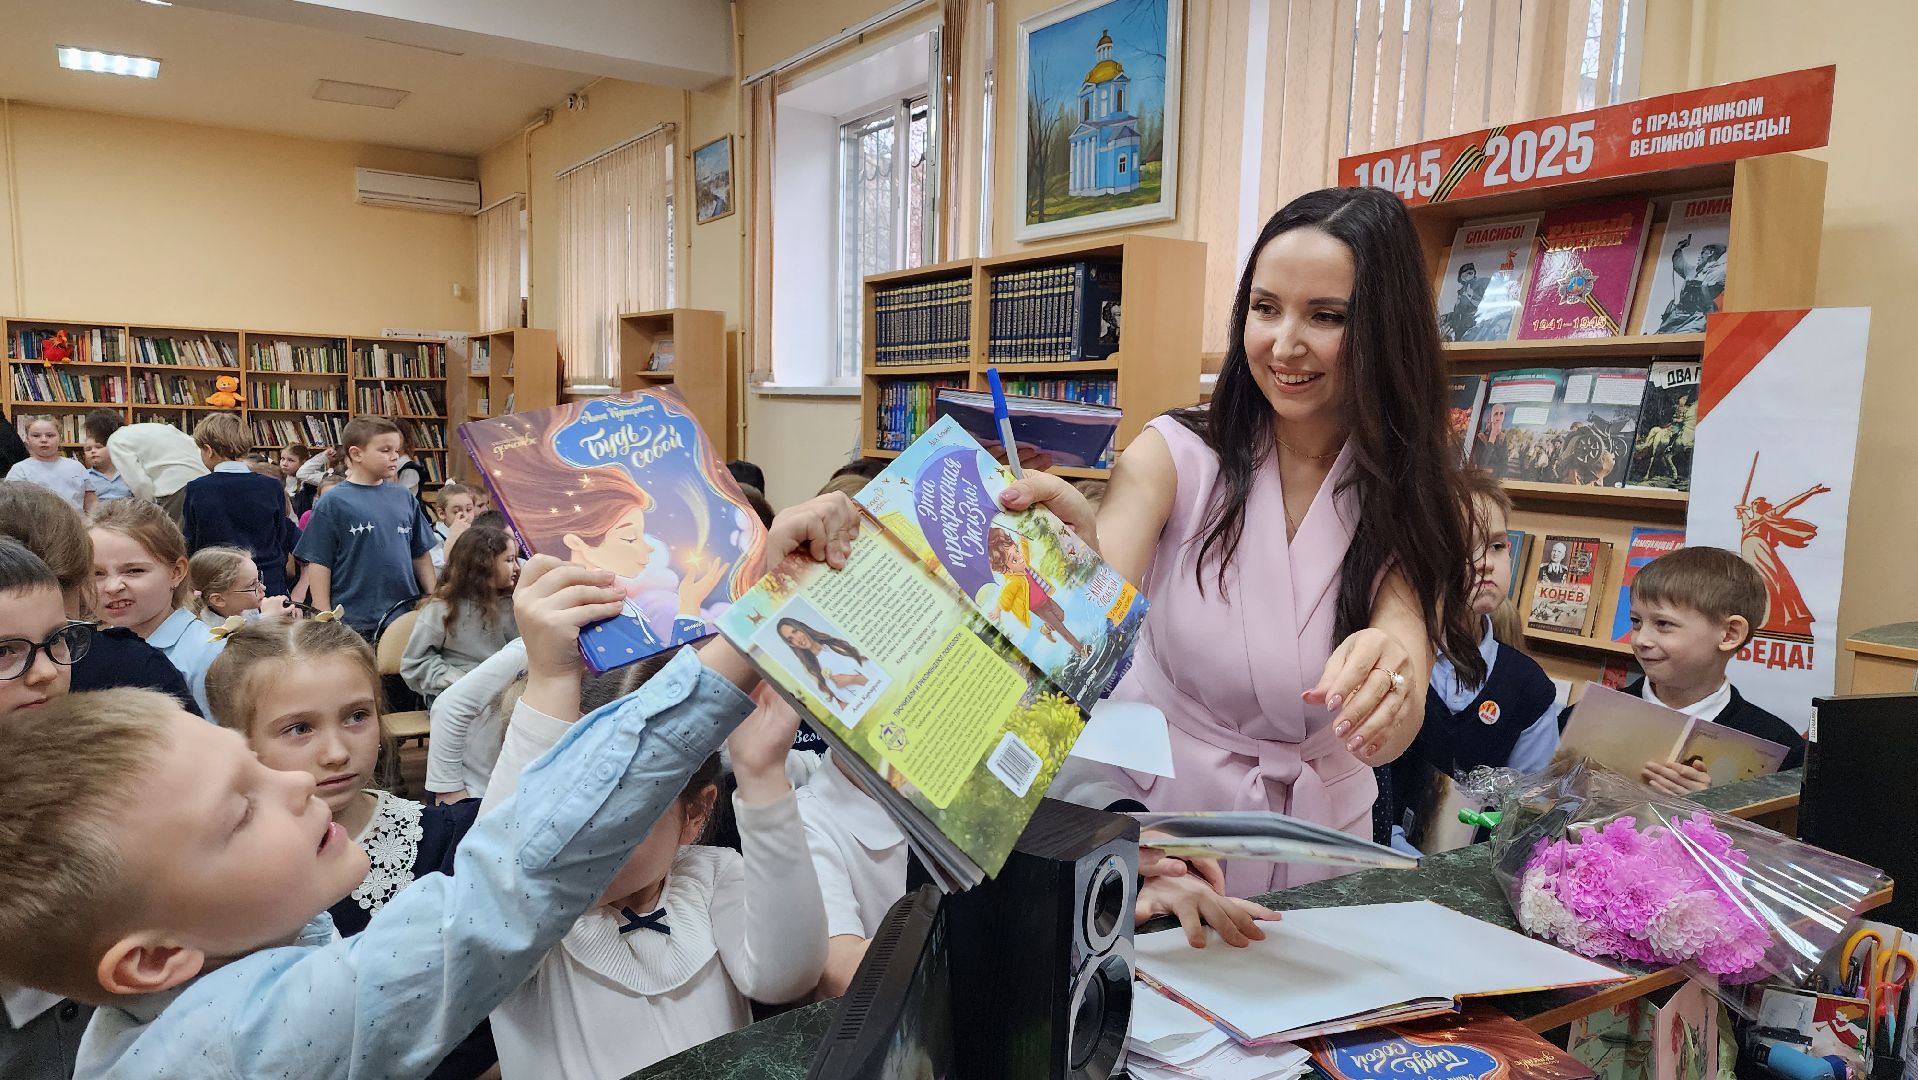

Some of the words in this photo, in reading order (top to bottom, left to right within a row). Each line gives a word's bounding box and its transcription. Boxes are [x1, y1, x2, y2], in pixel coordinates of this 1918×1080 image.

[1632, 116, 1643, 133] С
[1647, 97, 1764, 132] ПРАЗДНИКОМ
[1630, 127, 1706, 158] ВЕЛИКОЙ
[1710, 116, 1791, 147] ПОБЕДЫ!
[1354, 149, 1442, 199] 1945
[1484, 121, 1596, 188] 2025
[1685, 199, 1732, 217] ПОМН
[1465, 224, 1526, 244] СПАСИБО!
[1667, 368, 1692, 386] ДВА
[579, 424, 652, 460] Будь
[632, 424, 685, 468] собой
[918, 479, 938, 521] Эта
[940, 457, 974, 568] прекрасная
[1539, 587, 1584, 602] КОНЕВ
[1736, 640, 1814, 670] БЕДА!
[1350, 1041, 1407, 1073] собой
[1391, 1049, 1468, 1074] Будь
